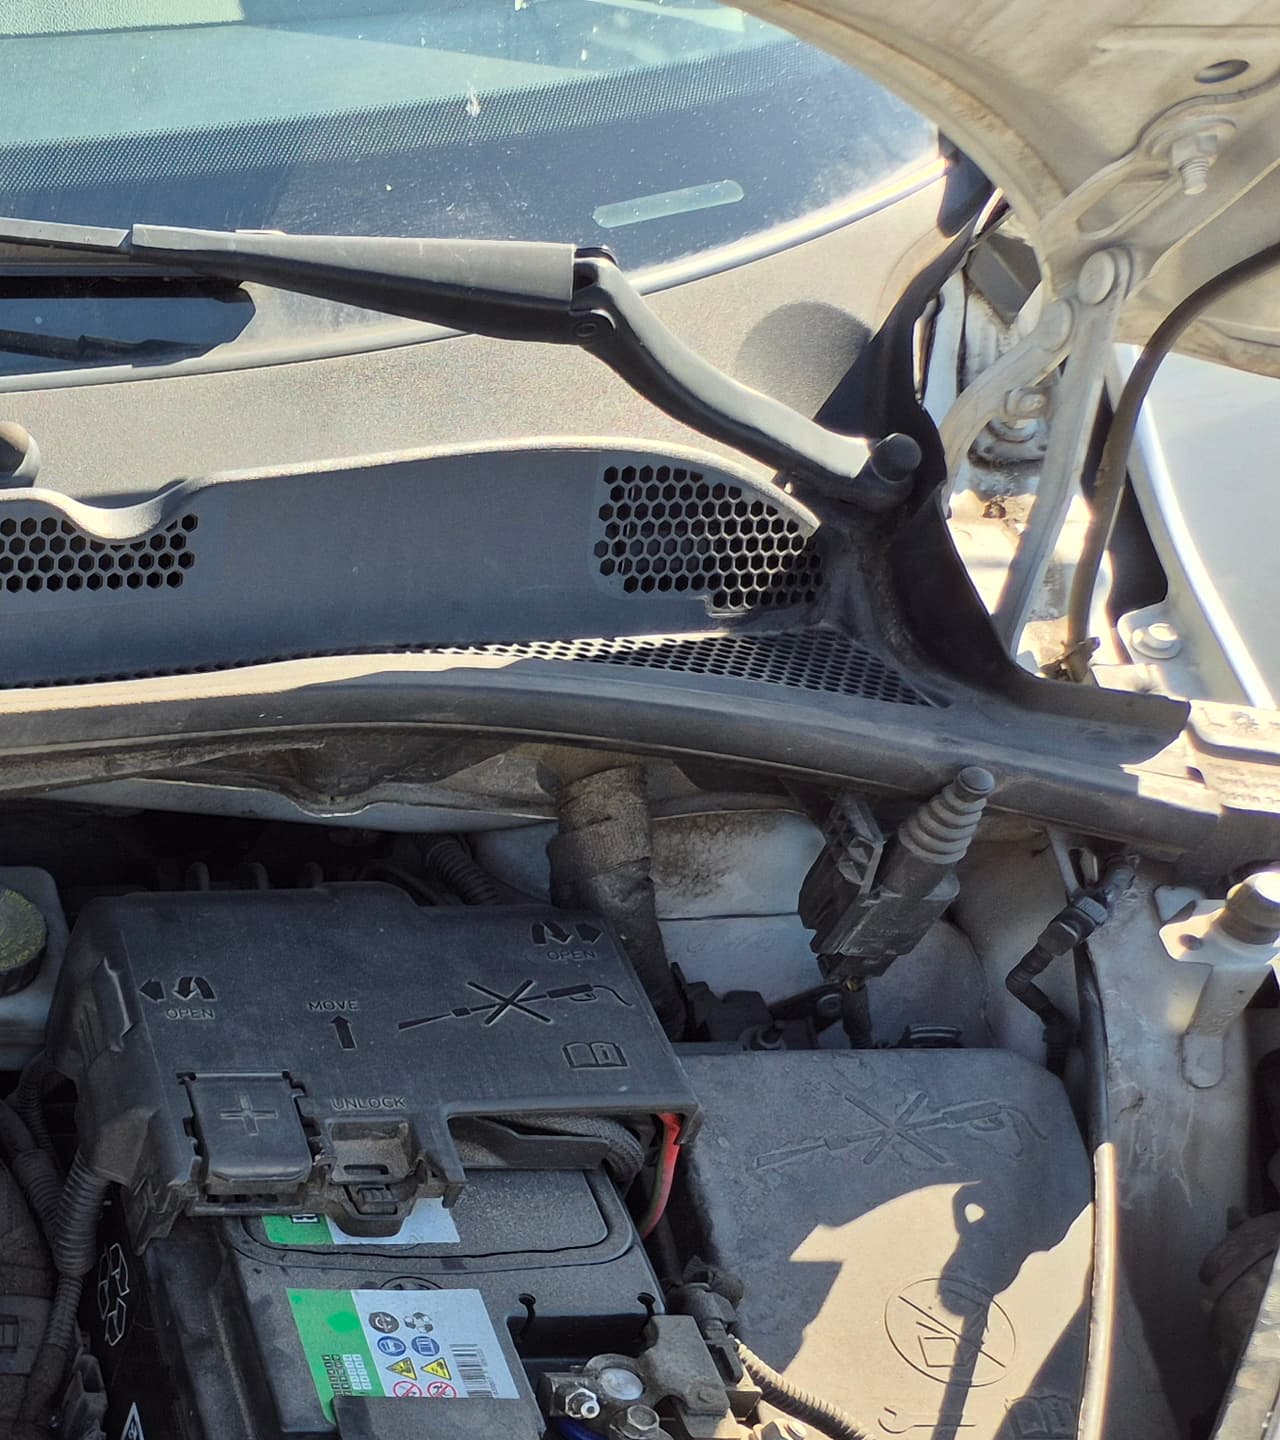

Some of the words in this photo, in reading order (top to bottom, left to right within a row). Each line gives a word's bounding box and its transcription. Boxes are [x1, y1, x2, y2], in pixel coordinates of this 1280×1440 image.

[546, 949, 596, 961] OPEN
[308, 1000, 359, 1012] MOVE
[166, 1008, 215, 1020] OPEN
[330, 1096, 407, 1110] UNLOCK
